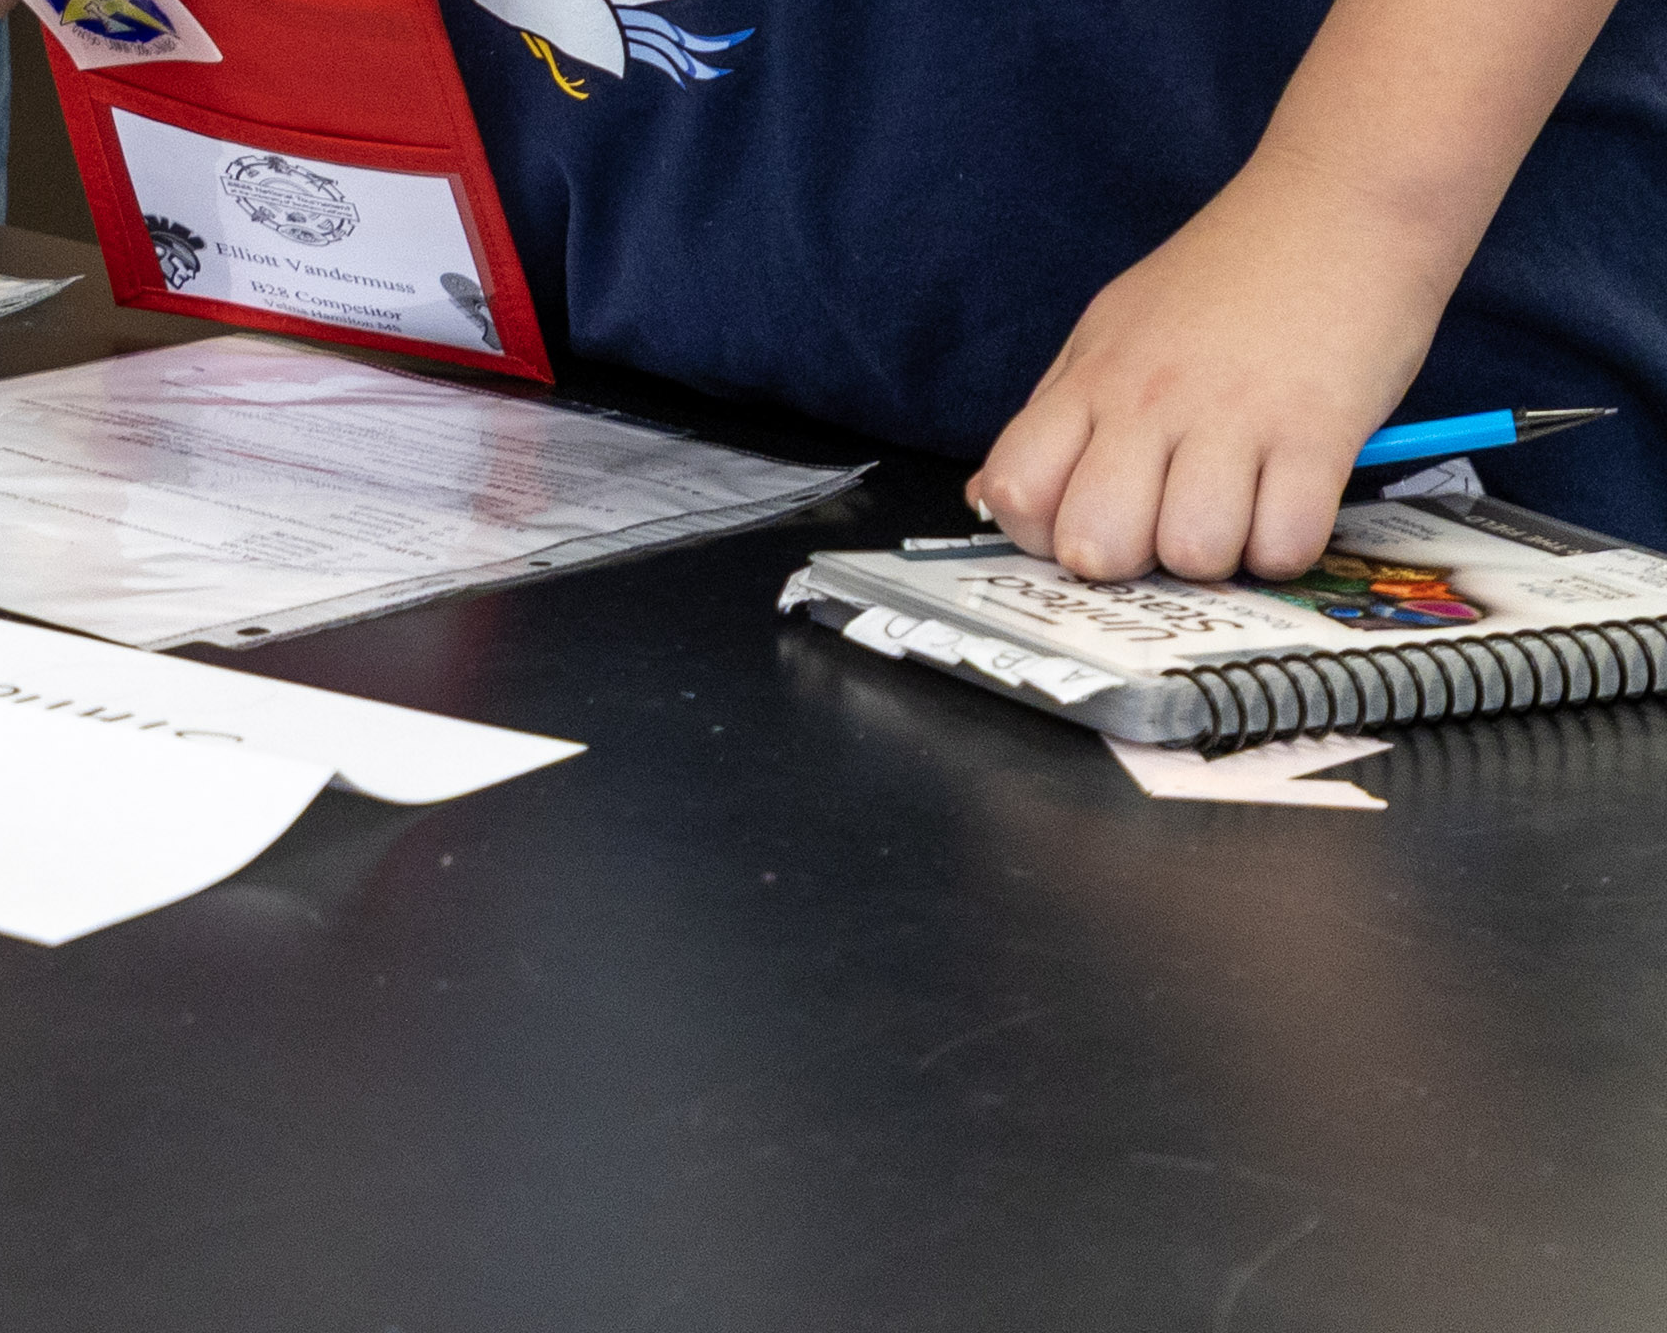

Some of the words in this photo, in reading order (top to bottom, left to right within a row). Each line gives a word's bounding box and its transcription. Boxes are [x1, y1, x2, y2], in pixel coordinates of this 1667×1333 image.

[215, 243, 280, 268] Elliott
[286, 258, 417, 294] Vandermuss
[250, 280, 290, 298] B28
[295, 289, 404, 322] Competitor
[957, 575, 1179, 643] United
